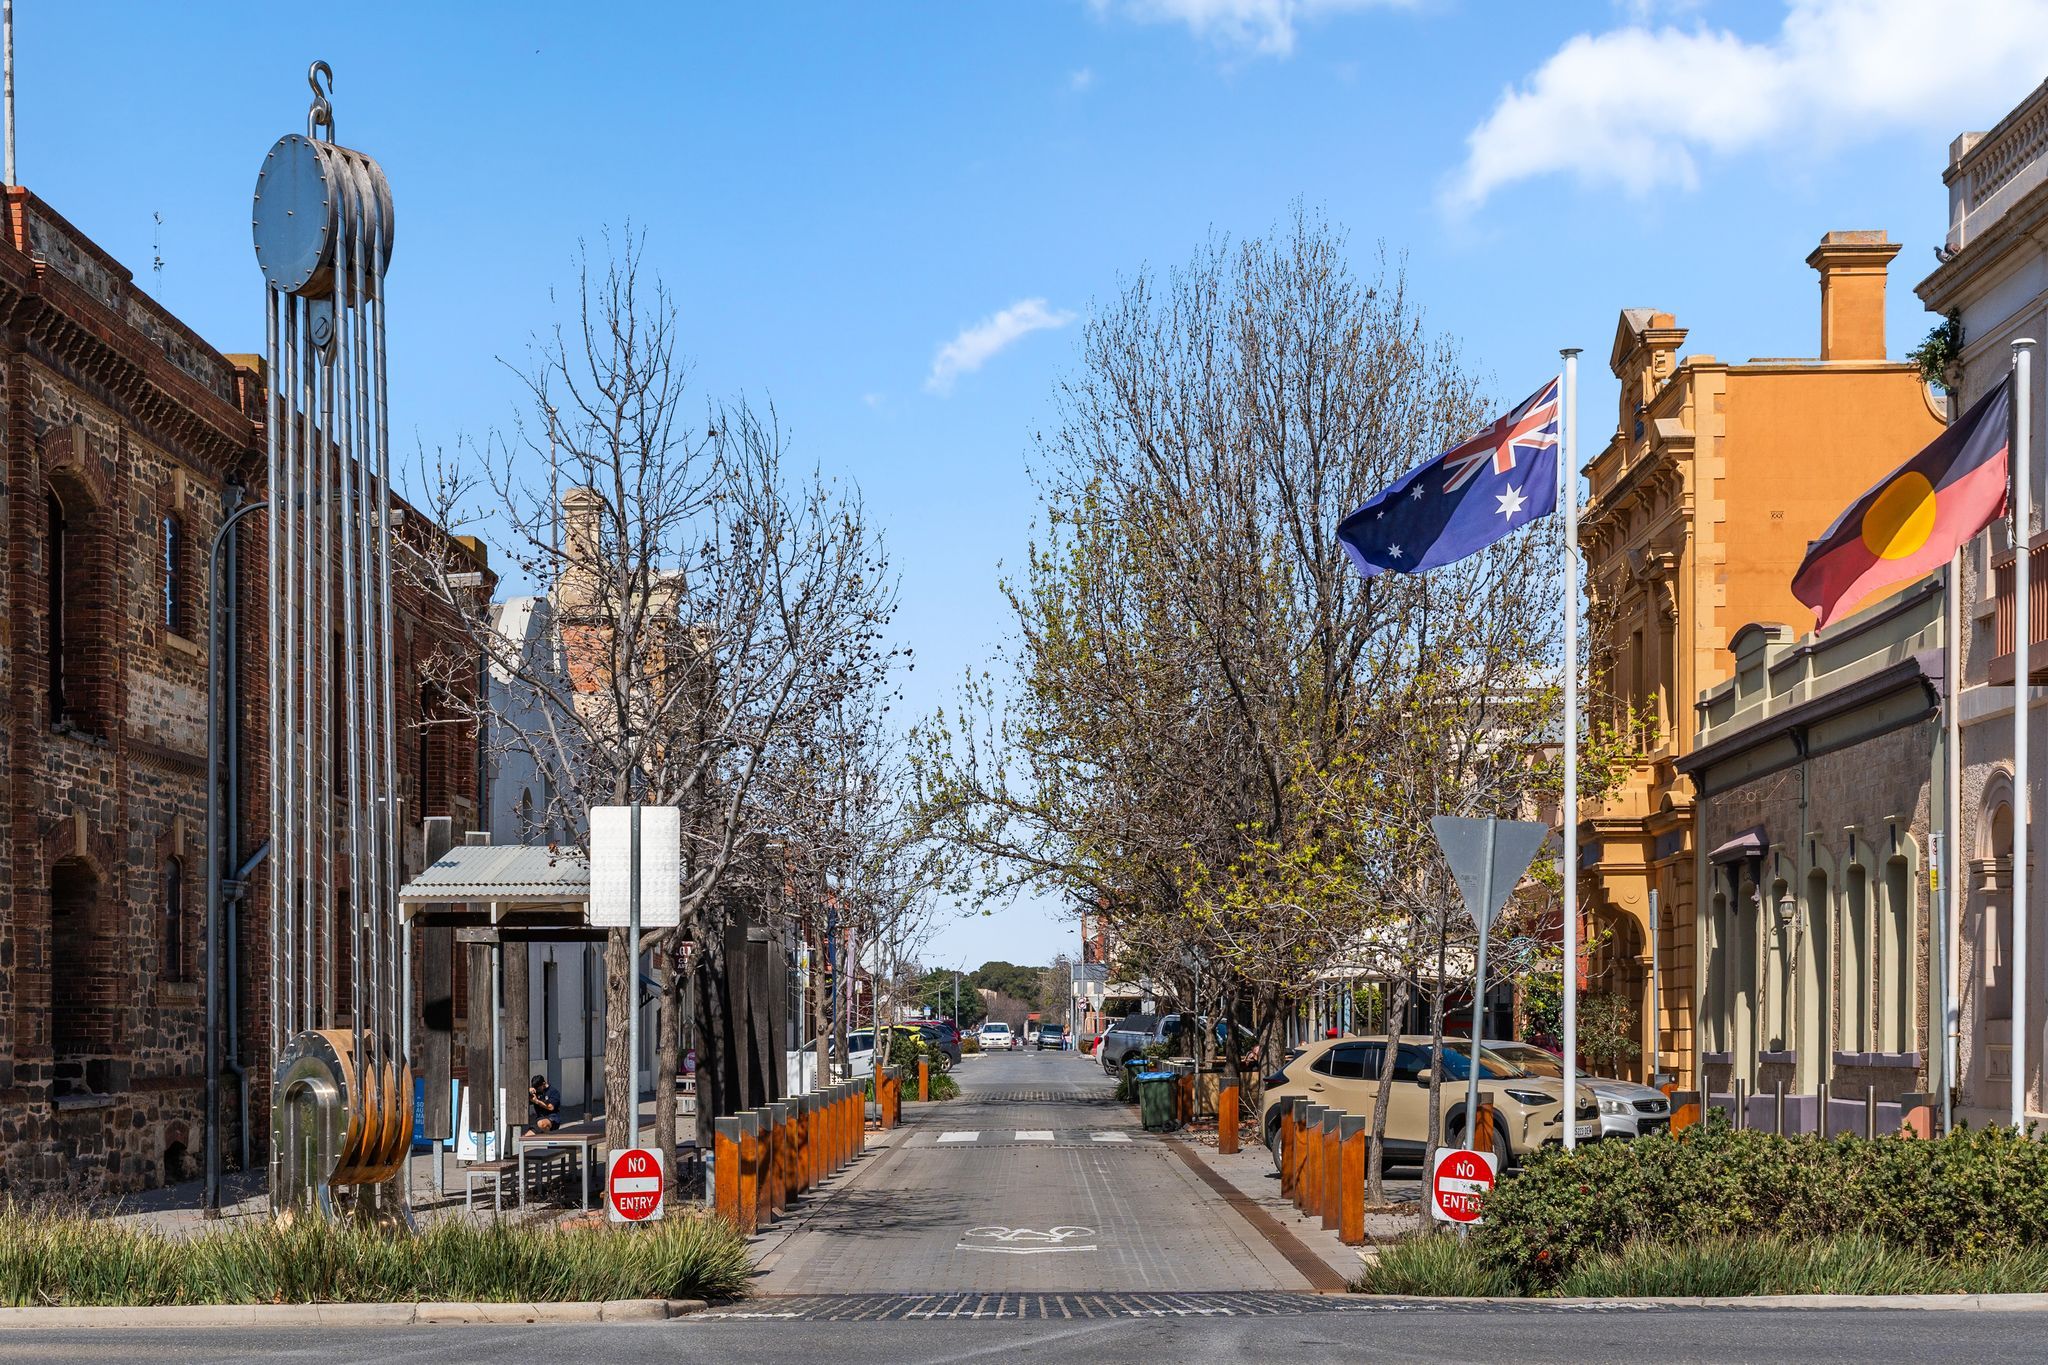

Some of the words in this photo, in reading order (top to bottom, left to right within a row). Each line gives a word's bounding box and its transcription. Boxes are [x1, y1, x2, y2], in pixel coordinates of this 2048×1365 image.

[628, 1157, 646, 1173] NO
[1456, 1162, 1475, 1178] NO
[620, 1196, 654, 1211] ENTRY
